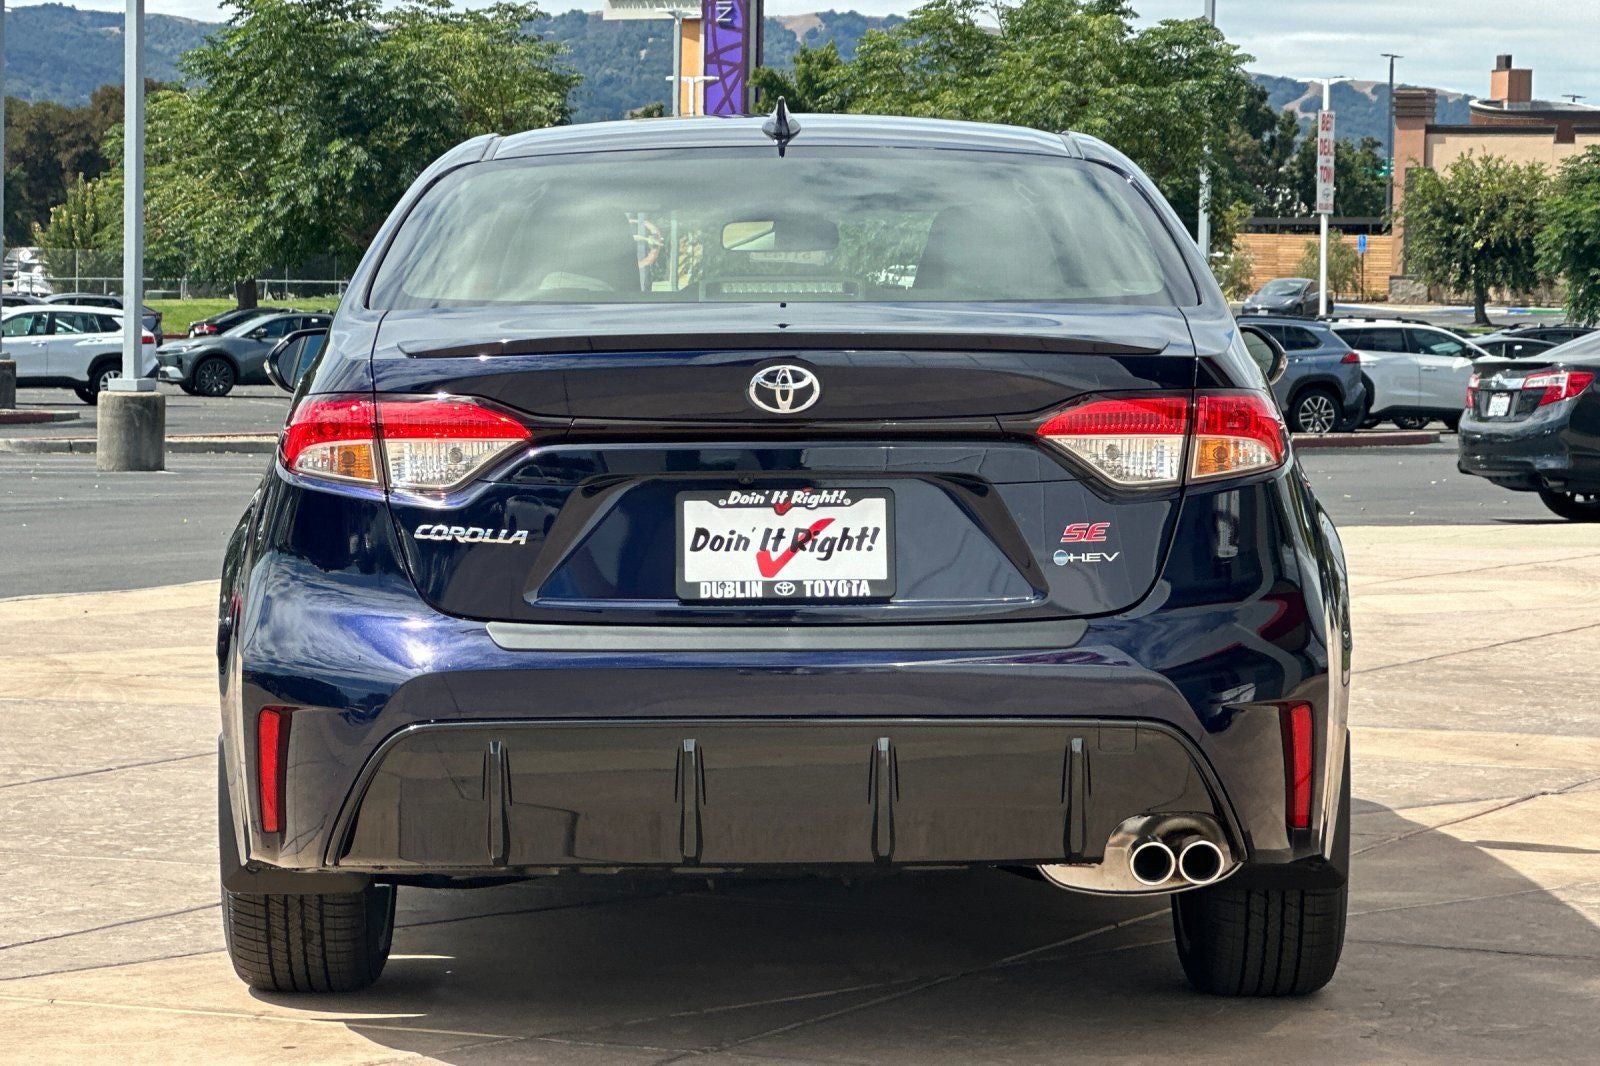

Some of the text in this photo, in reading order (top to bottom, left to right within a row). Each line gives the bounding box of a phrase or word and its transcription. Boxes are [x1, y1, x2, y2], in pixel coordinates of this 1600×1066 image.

[725, 490, 847, 508] Doin' It Right!
[414, 524, 529, 545] COROLLA
[1060, 522, 1111, 543] SE
[689, 526, 881, 561] Doin' It Right!
[1068, 551, 1120, 562] HEV
[700, 580, 871, 598] DUBLIN TOYOTA
